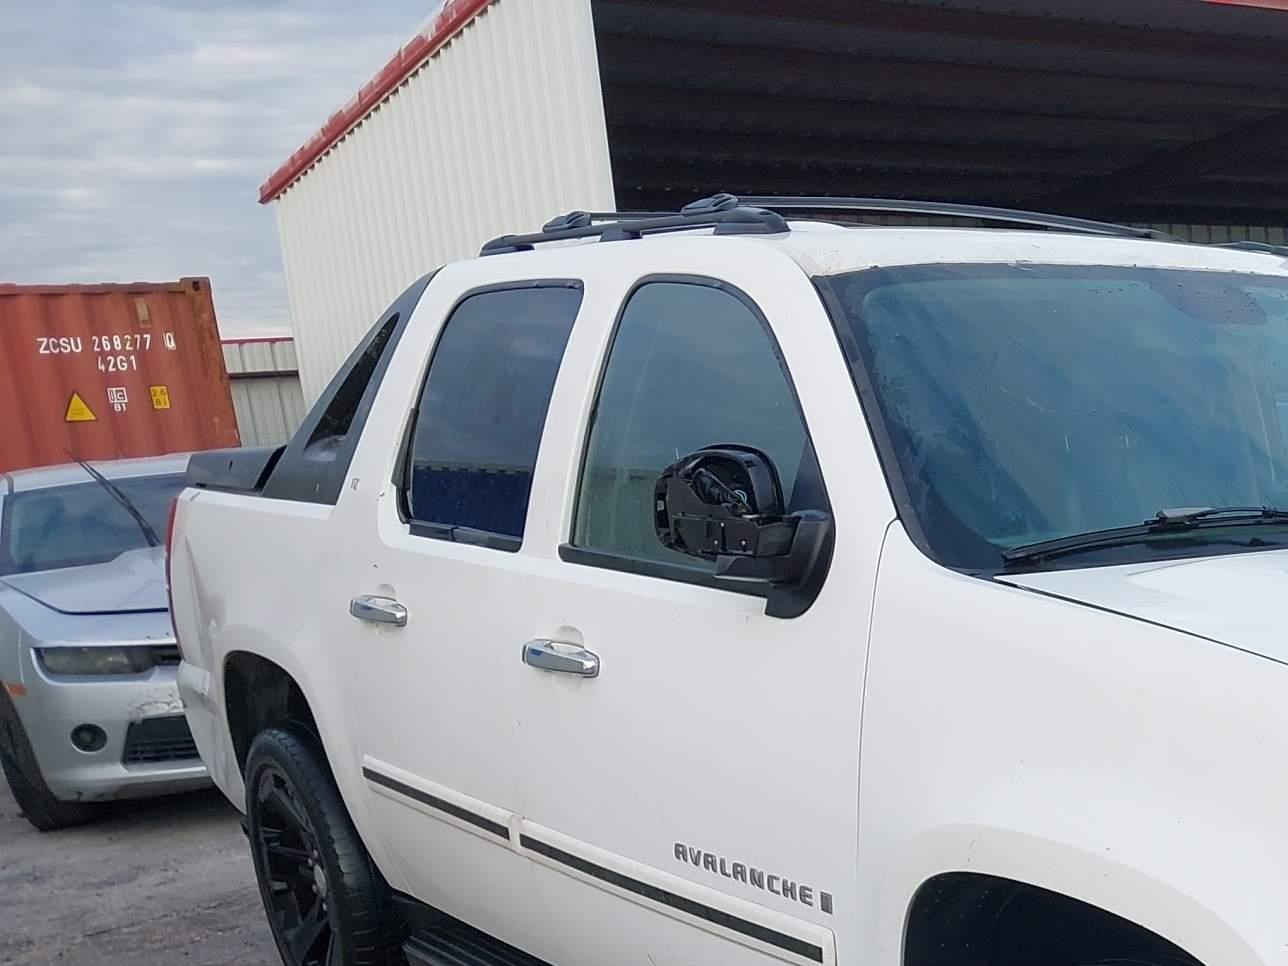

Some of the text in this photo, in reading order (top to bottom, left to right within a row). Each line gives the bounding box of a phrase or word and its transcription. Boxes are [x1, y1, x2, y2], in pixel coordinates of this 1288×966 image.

[37, 337, 82, 354] ZCSU
[92, 334, 151, 352] 268277
[98, 355, 137, 372] 42G1
[674, 842, 814, 907] AVALANCHE
